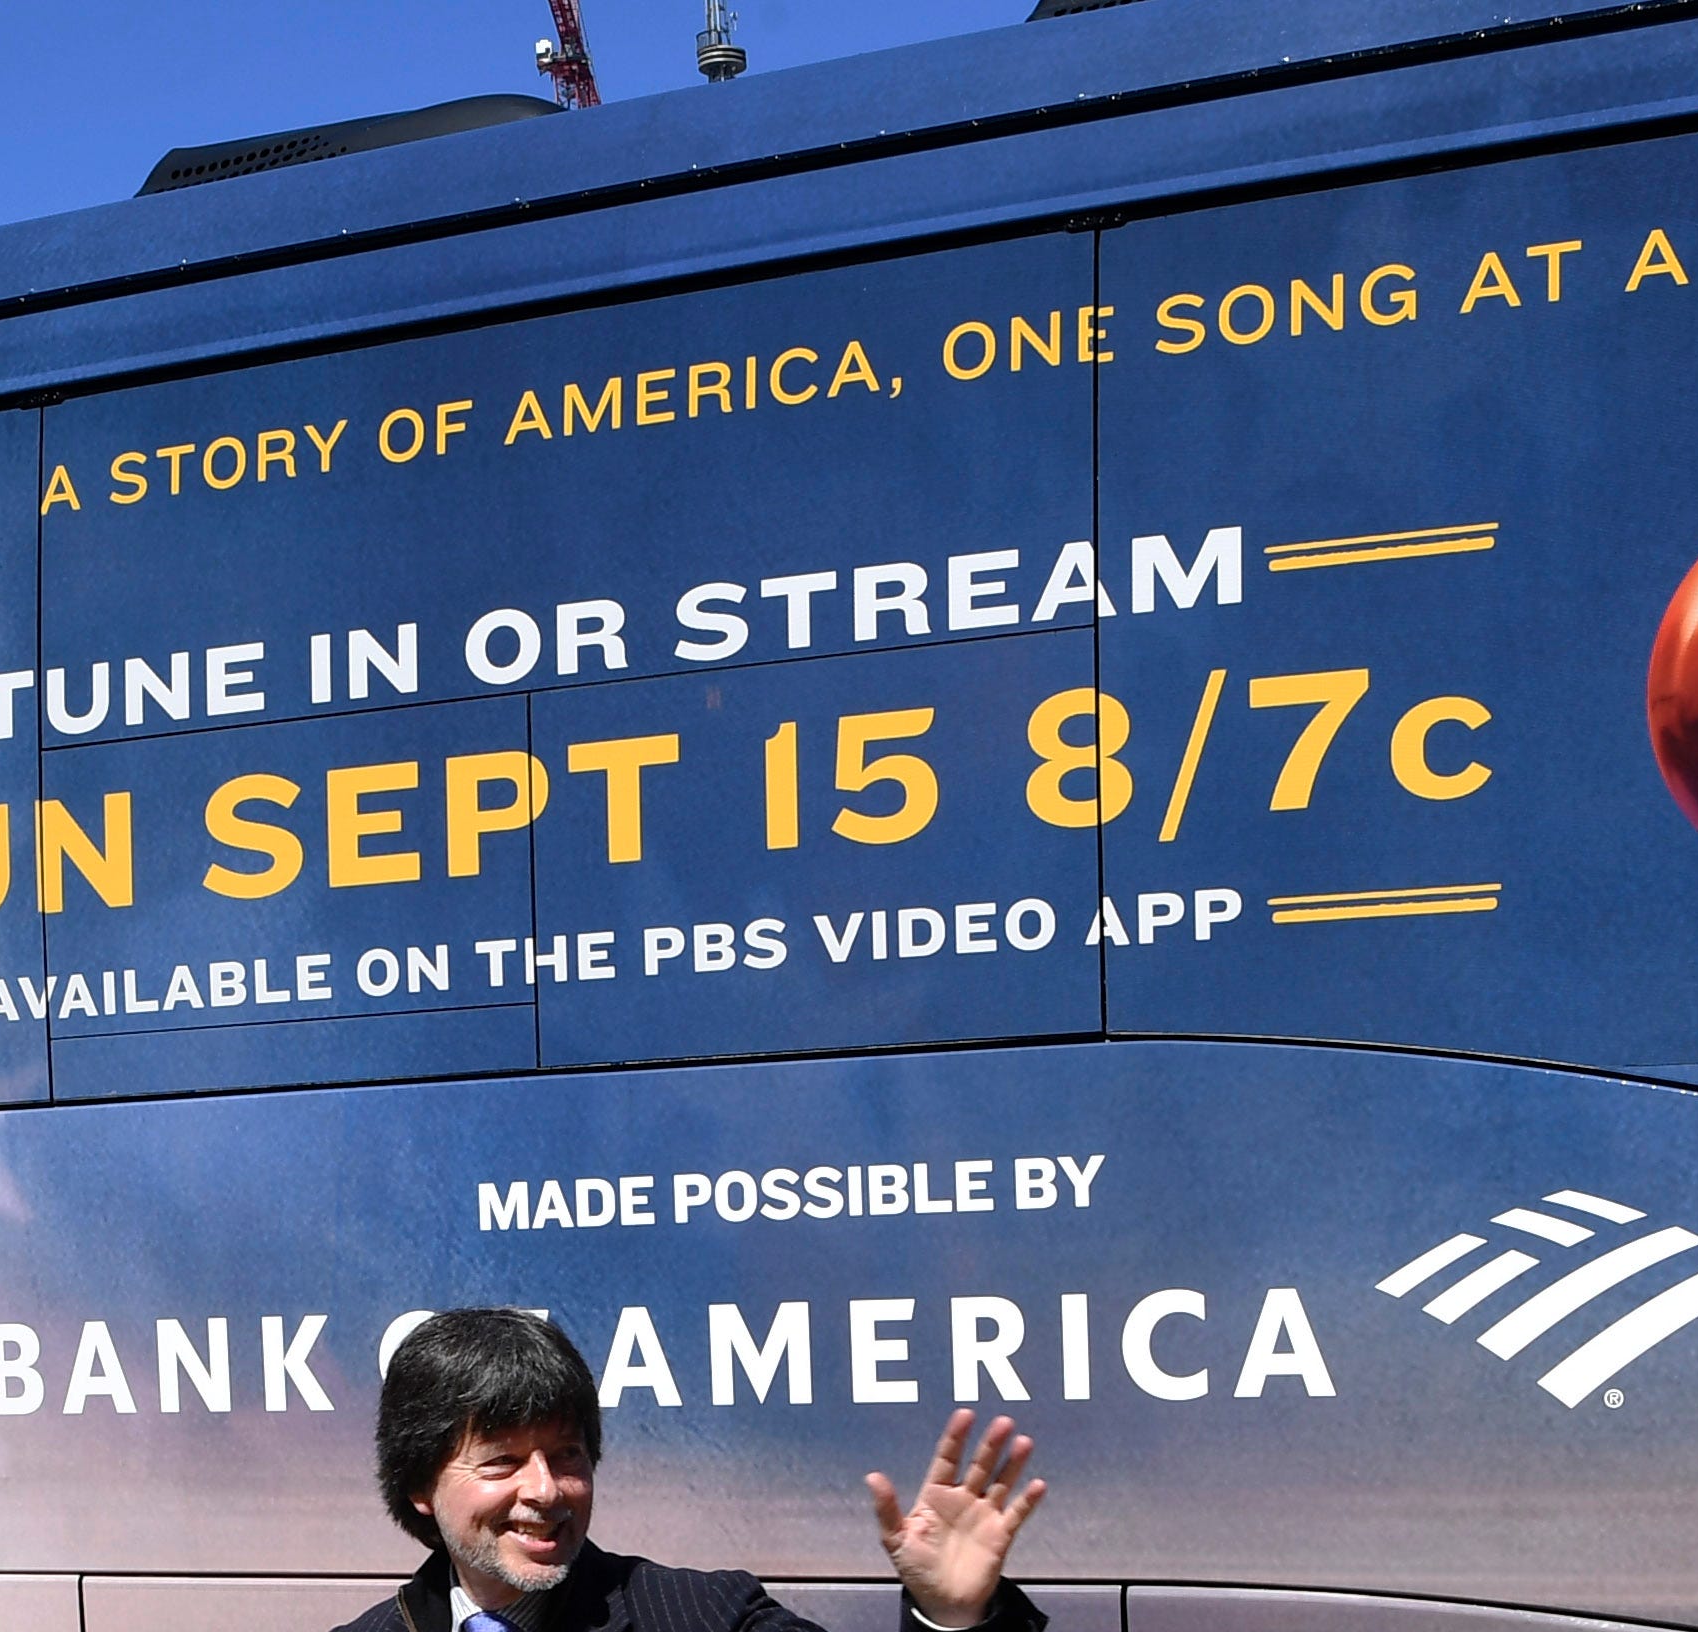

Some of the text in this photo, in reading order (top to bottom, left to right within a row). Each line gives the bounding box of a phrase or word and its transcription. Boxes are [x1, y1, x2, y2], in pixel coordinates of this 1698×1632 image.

[40, 464, 81, 515] A
[109, 419, 348, 504] STORY
[379, 399, 473, 463] OF
[504, 340, 904, 444] AMERICA,
[943, 304, 1115, 380] ONE
[1155, 262, 1418, 355] SONG
[1460, 239, 1583, 314] AT
[1625, 228, 1690, 292] A
[310, 621, 419, 705] IN
[464, 598, 629, 686] OR
[673, 525, 1244, 662] STREAM
[202, 732, 681, 899] SEPT
[765, 707, 940, 850] 15
[356, 943, 450, 998] ON
[474, 930, 617, 988] THE
[643, 917, 789, 977] PBS
[812, 897, 1058, 964] VIDEO
[1084, 887, 1244, 948] APP
[477, 1153, 1107, 1233] MADE POSSIBLE BY
[597, 1287, 1339, 1409] AMERICA
